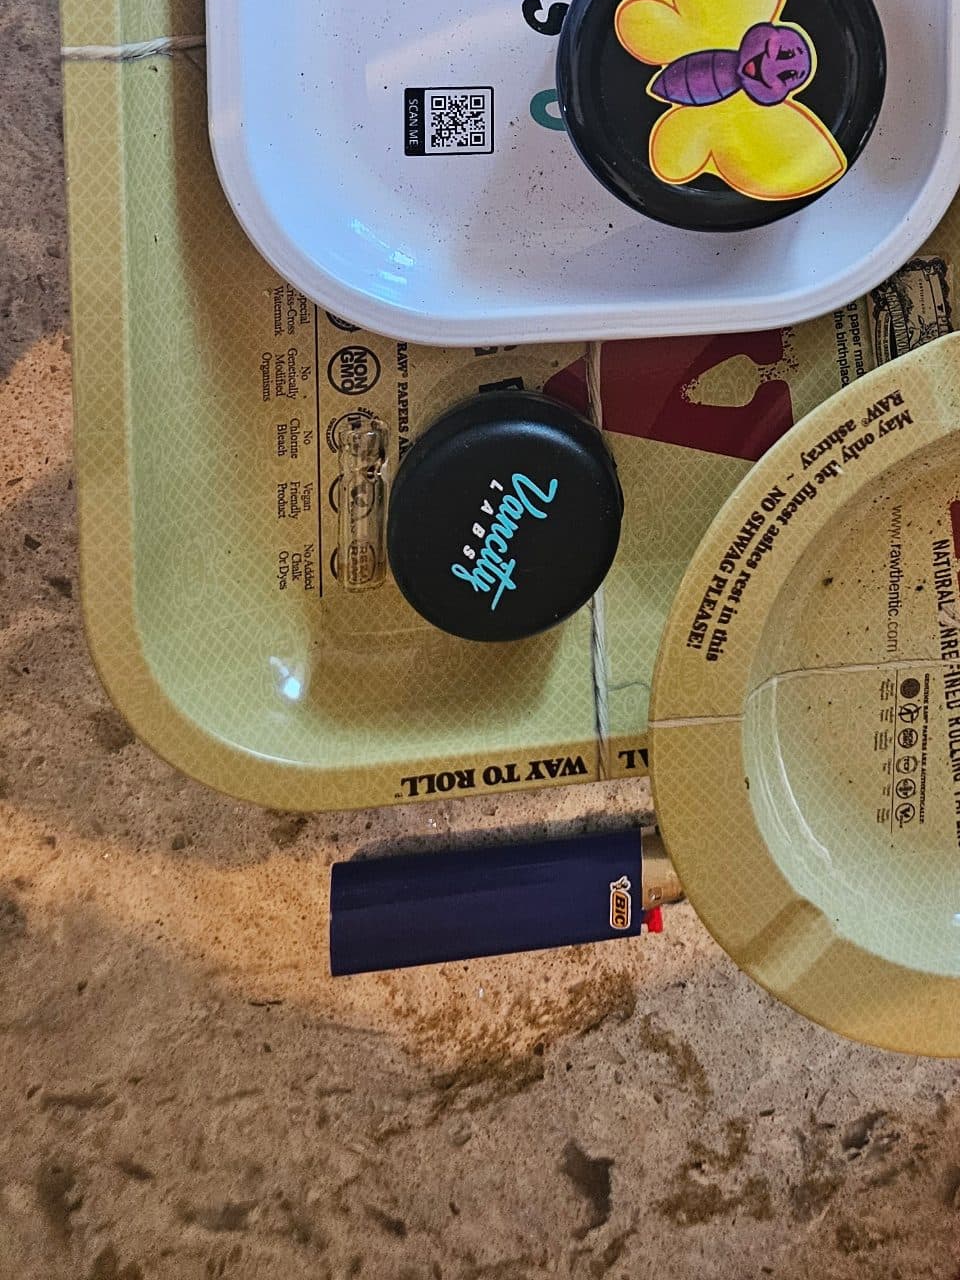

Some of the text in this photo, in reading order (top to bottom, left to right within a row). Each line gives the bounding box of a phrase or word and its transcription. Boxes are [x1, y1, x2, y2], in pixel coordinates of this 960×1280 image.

[408, 98, 419, 146] SCAN ME
[273, 286, 285, 337] Watermark
[847, 313, 862, 348] paper
[353, 350, 369, 390] NON
[833, 310, 851, 389] the birthplac
[854, 349, 867, 378] mad
[260, 352, 273, 402] Organisms
[275, 354, 286, 397] Modified
[286, 347, 298, 400] Genetically
[301, 366, 312, 381] No
[340, 351, 354, 393] GMO
[397, 382, 410, 433] PAPERS
[277, 423, 288, 457] Bleach
[289, 417, 301, 459] Chlorine
[303, 430, 313, 446] No
[801, 418, 858, 471] ashtray
[277, 482, 288, 519] Product
[288, 481, 301, 520] Friendly
[301, 481, 313, 511] Vegan
[462, 479, 504, 560] LABS
[705, 408, 914, 662] May only the finest ashes rest in this
[451, 473, 559, 611] Vancity
[276, 550, 290, 591] Or Dyes
[291, 552, 302, 582] Chalk
[303, 543, 315, 591] No Added
[685, 485, 788, 651] NO SHWAG PLEASE!
[886, 505, 904, 653] www.rawthentic.com
[931, 538, 956, 611] NATURAL
[482, 764, 521, 786] TO
[525, 755, 588, 781] WAY
[614, 894, 626, 927] BIC
